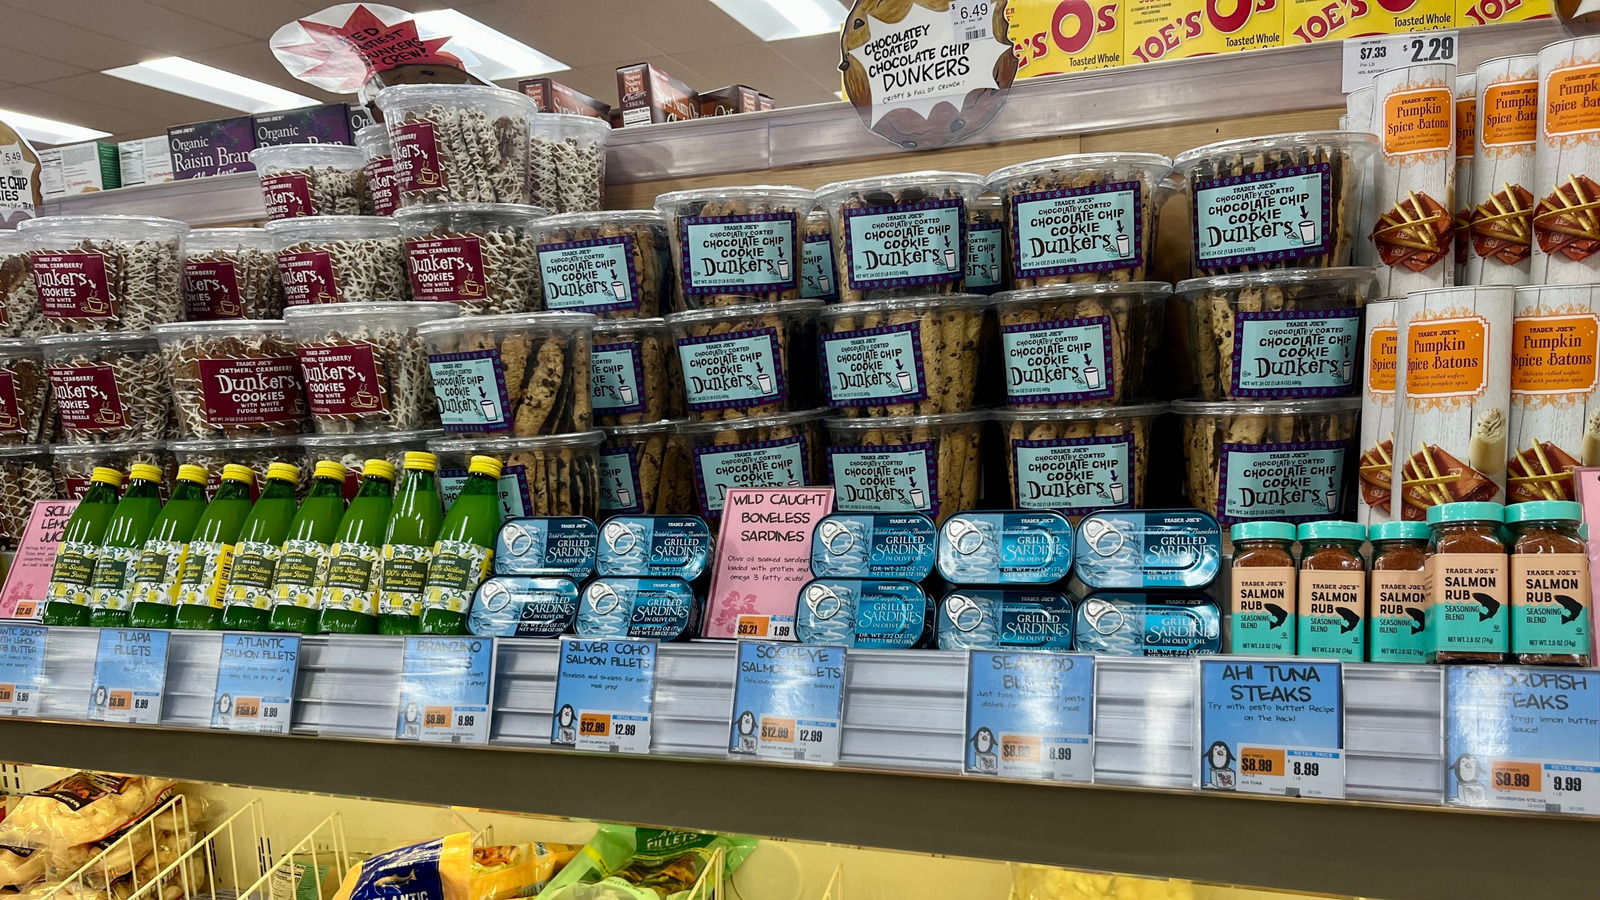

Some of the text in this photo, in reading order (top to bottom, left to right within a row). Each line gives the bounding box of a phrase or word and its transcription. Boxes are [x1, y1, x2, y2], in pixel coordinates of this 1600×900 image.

[961, 3, 988, 20] 6.49
[1394, 14, 1451, 28] Toasted Whole
[865, 24, 930, 56] CHOCOLATEY
[1132, 10, 1201, 62] JOE'S
[381, 48, 429, 65] CREW!
[874, 39, 918, 62] COATED
[1360, 47, 1386, 60] $7.33
[1411, 37, 1454, 62] 2.29
[868, 43, 970, 78] CHOCOLATE CHIP
[1070, 53, 1120, 66] Toasted Whole
[883, 57, 970, 92] DUNKERS
[882, 92, 905, 104] CRISPY
[1397, 103, 1441, 118] Pumpkin
[258, 125, 299, 141] Organic
[1388, 118, 1448, 136] Spice Batons
[172, 136, 208, 152] Organic
[173, 152, 214, 172] Raisin
[218, 148, 251, 166] Bran
[8, 176, 28, 190] CHIP
[1233, 184, 1256, 193] TRADER
[1216, 187, 1294, 203] CHOCOLATEY COATED
[1208, 193, 1309, 216] CHOCOLATE CHIP
[1228, 209, 1281, 224] COOKIE
[710, 230, 749, 238] CHOCOLATEY
[1206, 221, 1294, 247] Dunkers
[703, 236, 784, 249] CHOCOLATE CHIP
[721, 248, 764, 259] COOKIE
[701, 258, 774, 276] Dunkers
[1524, 333, 1581, 351] Pumpkin
[1513, 353, 1592, 370] Spice Batons
[214, 373, 295, 394] Dunkers
[232, 392, 285, 402] COOKIES
[1027, 481, 1105, 499] Dunkers
[733, 494, 826, 506] WILD CAUGHT
[741, 513, 811, 523] BONELESS
[741, 531, 805, 542] SARDINES
[886, 536, 925, 544] GRILLED
[872, 544, 933, 561] SARDINES
[401, 570, 424, 578] Sicilian
[1445, 577, 1496, 587] SALMON
[1445, 590, 1470, 600] RUB
[873, 603, 914, 611] GRILLED
[1445, 605, 1480, 613] SEASONING
[20, 629, 45, 637] SALMON
[118, 631, 151, 643] TILAPIA
[738, 625, 790, 636] $8.21 1.99
[11, 645, 36, 653] BUTTER
[237, 637, 285, 649] ATLANTIC
[418, 641, 481, 653] BRANZINO
[569, 641, 650, 656] SILVER COHO
[115, 645, 151, 657] FILLETS
[224, 649, 296, 661] SALMON FILLETS
[756, 645, 829, 663] SOCKEYE
[566, 655, 650, 669] SALMON FILLETS
[563, 671, 585, 679] Boneless
[794, 665, 841, 679] FILLETS
[1222, 665, 1320, 682] AHI TUNA
[1230, 685, 1312, 702] STEAKS
[135, 699, 148, 709] 6.99
[1207, 701, 1222, 710] Try
[1276, 704, 1305, 712] butter!
[1309, 704, 1335, 714] Recipe
[1568, 717, 1599, 725] butter
[615, 723, 635, 735] 12.99
[762, 726, 823, 742] $12.99 12.99
[1049, 747, 1071, 760] 8.99
[1242, 758, 1319, 776] $8.99 8.99
[1554, 776, 1582, 792] 9.99
[647, 834, 697, 850] FILLETS
